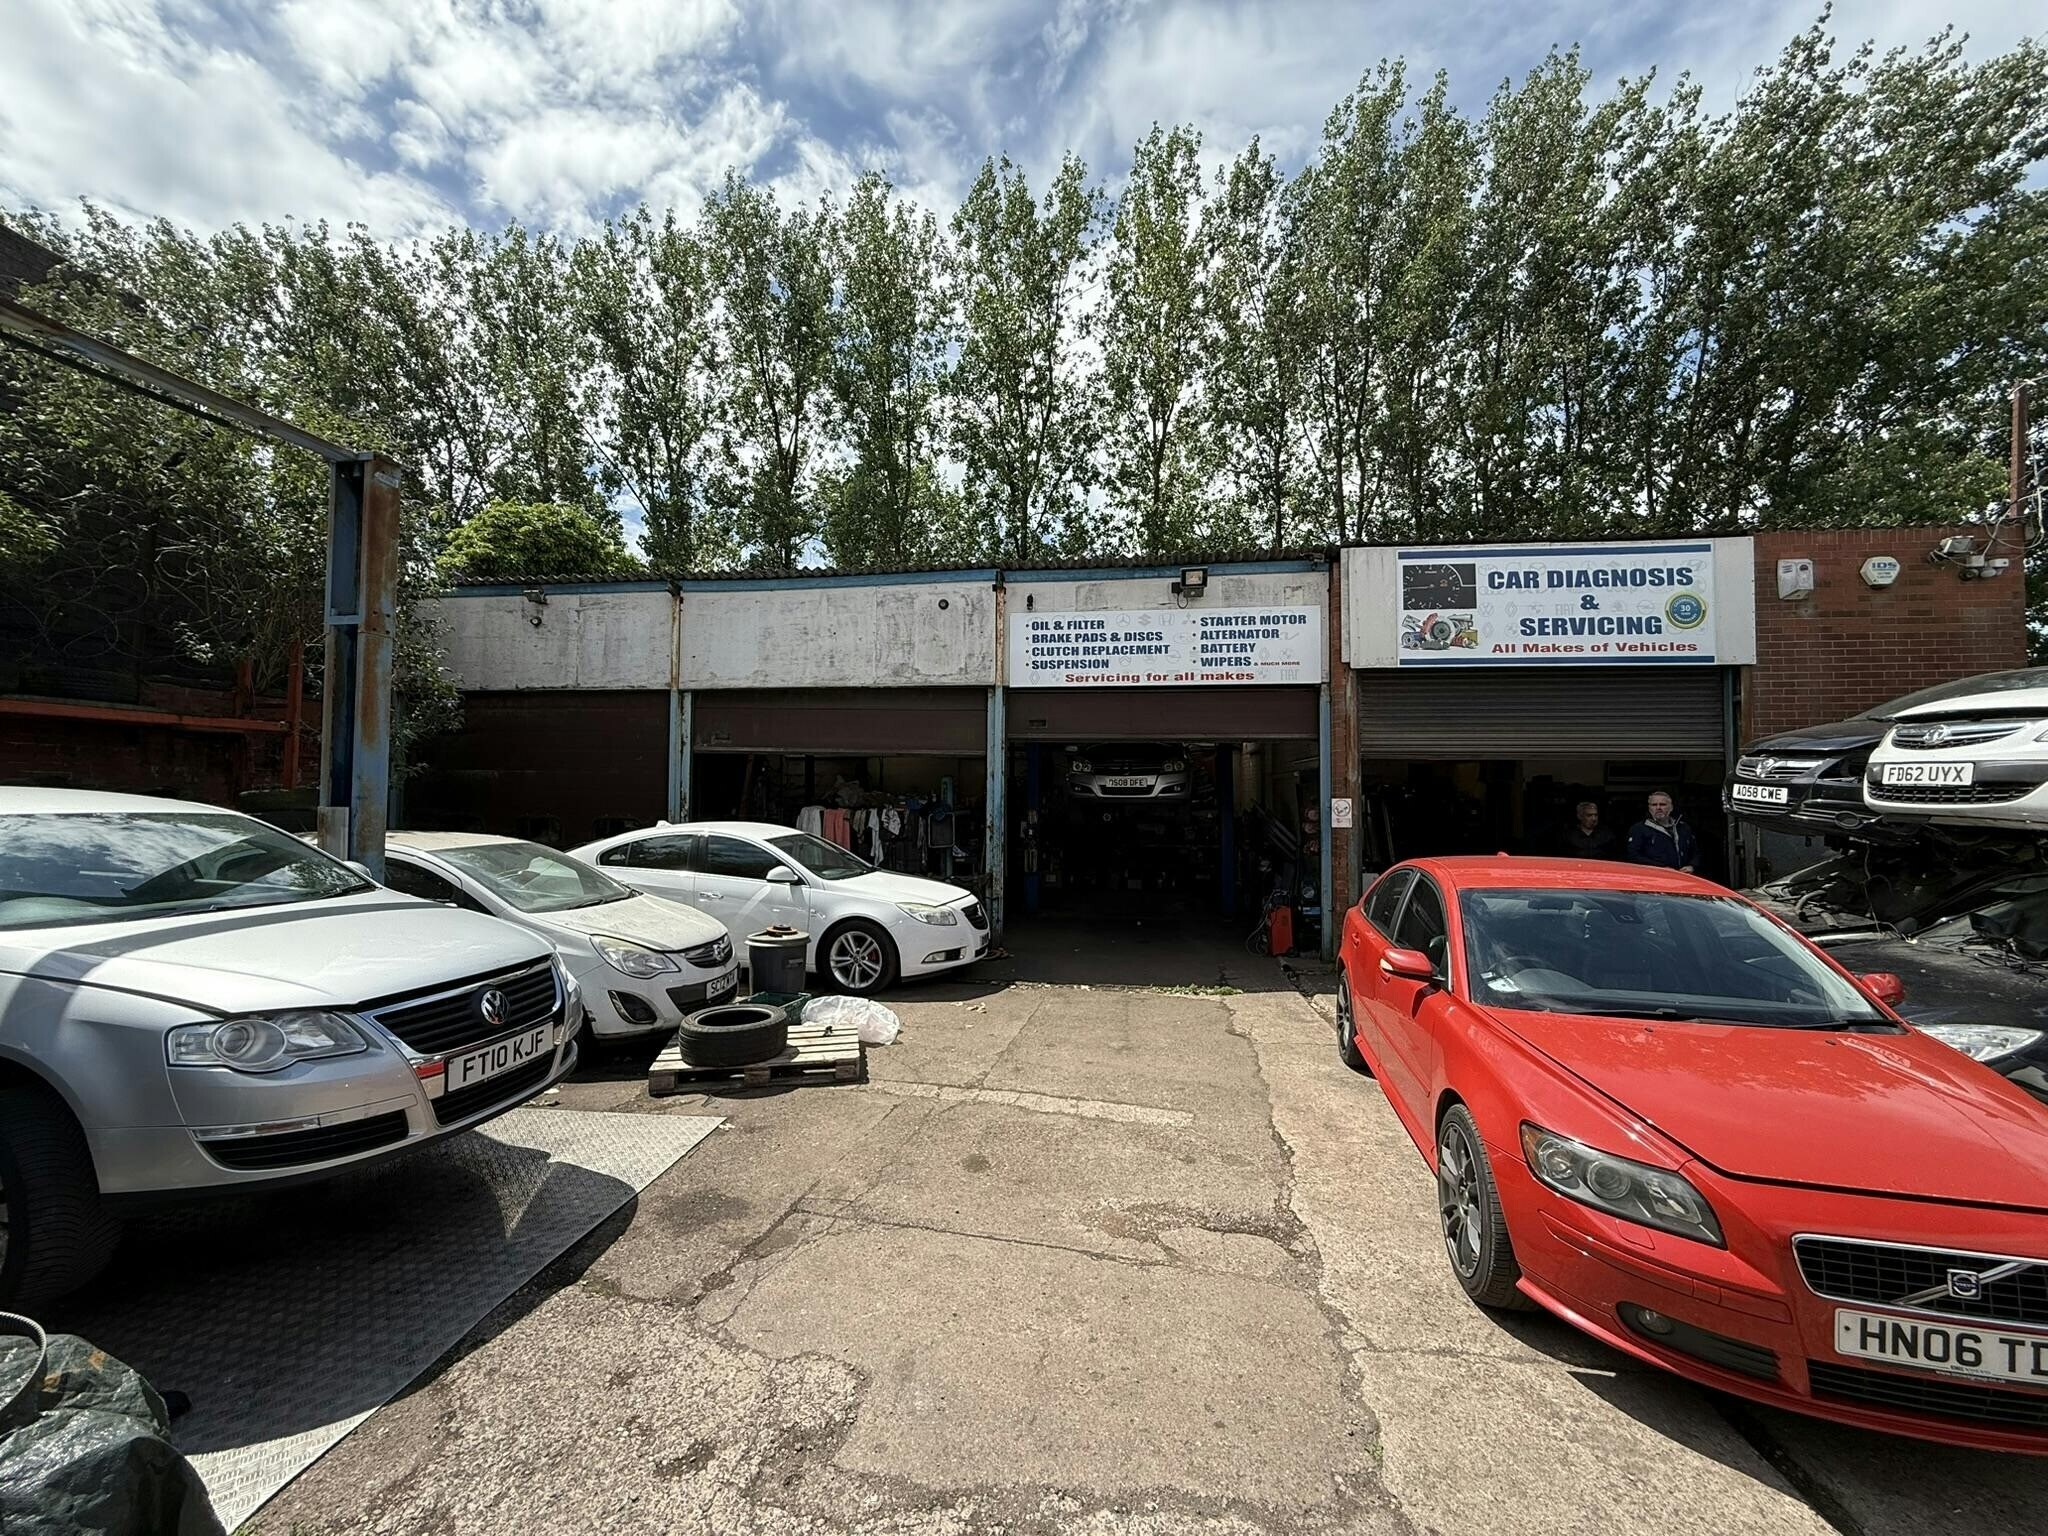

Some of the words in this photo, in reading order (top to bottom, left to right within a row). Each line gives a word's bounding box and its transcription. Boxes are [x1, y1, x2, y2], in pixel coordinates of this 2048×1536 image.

[1488, 571, 1540, 590] CAR
[1547, 567, 1694, 588] DIAGNOSIS
[1580, 594, 1600, 610] &
[1680, 604, 1691, 612] 30
[1032, 621, 1050, 630] OIL
[1053, 621, 1064, 630] &
[1067, 620, 1105, 630] FILTER
[1200, 616, 1256, 627] STARTER
[1260, 615, 1307, 625] MOTOR
[1520, 616, 1662, 636] SERVICING
[1032, 633, 1072, 643] BRAKE
[1075, 633, 1107, 643] PADS
[1110, 632, 1121, 642] &
[1124, 631, 1163, 642] DISCS
[1200, 629, 1280, 640] ALTERNATOR
[1032, 646, 1079, 656] CLUTCH
[1083, 644, 1170, 656] REPLACEMENT
[1201, 643, 1256, 653] BATTERY
[1492, 643, 1516, 653] All
[1523, 643, 1584, 653] Makes
[1590, 643, 1608, 652] of
[1615, 642, 1698, 652] Vehicles
[1032, 659, 1109, 669] SUSPENSION
[1201, 656, 1251, 667] WIPERS
[1065, 673, 1140, 683] Servicing
[1146, 672, 1169, 681] for
[1174, 672, 1195, 681] all
[1200, 672, 1254, 681] makes
[1888, 766, 1924, 782] FD62
[1928, 766, 1965, 782] UYX
[1761, 788, 1782, 800] CWE
[462, 1045, 508, 1082] FT10
[513, 1029, 545, 1062] KJF
[1860, 1317, 1982, 1367] HN06
